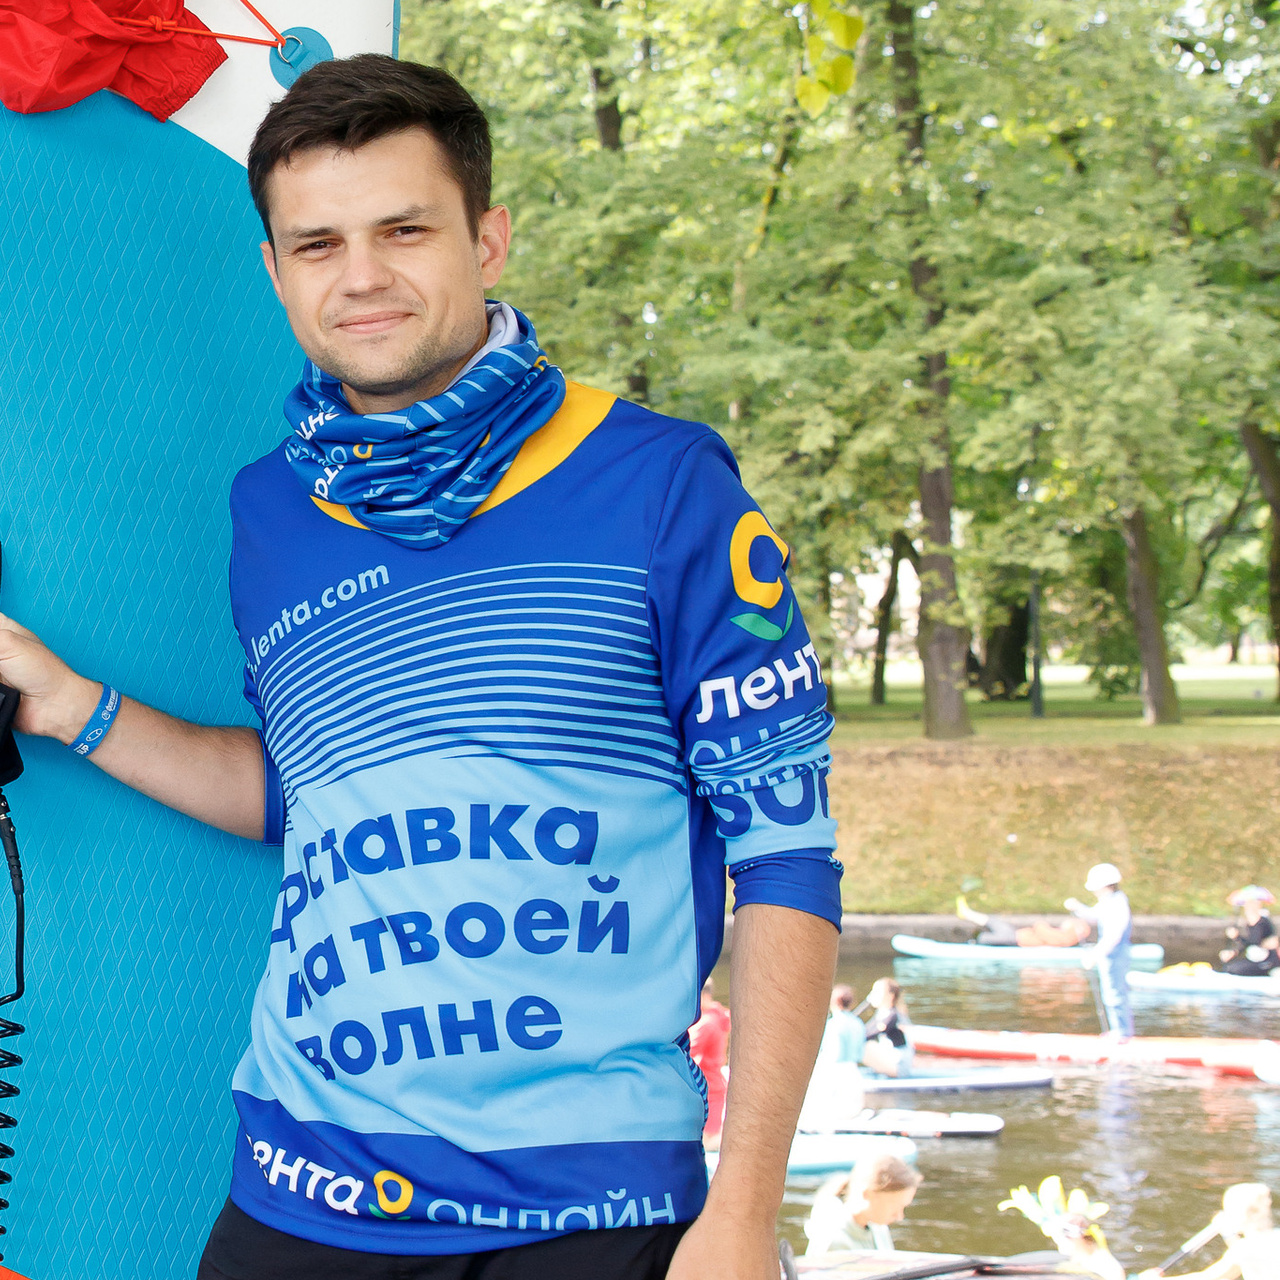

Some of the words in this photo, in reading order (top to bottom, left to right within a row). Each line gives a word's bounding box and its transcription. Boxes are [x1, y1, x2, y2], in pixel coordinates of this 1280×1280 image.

[696, 641, 823, 724] лент
[349, 875, 630, 975] твоей
[295, 994, 563, 1081] волне
